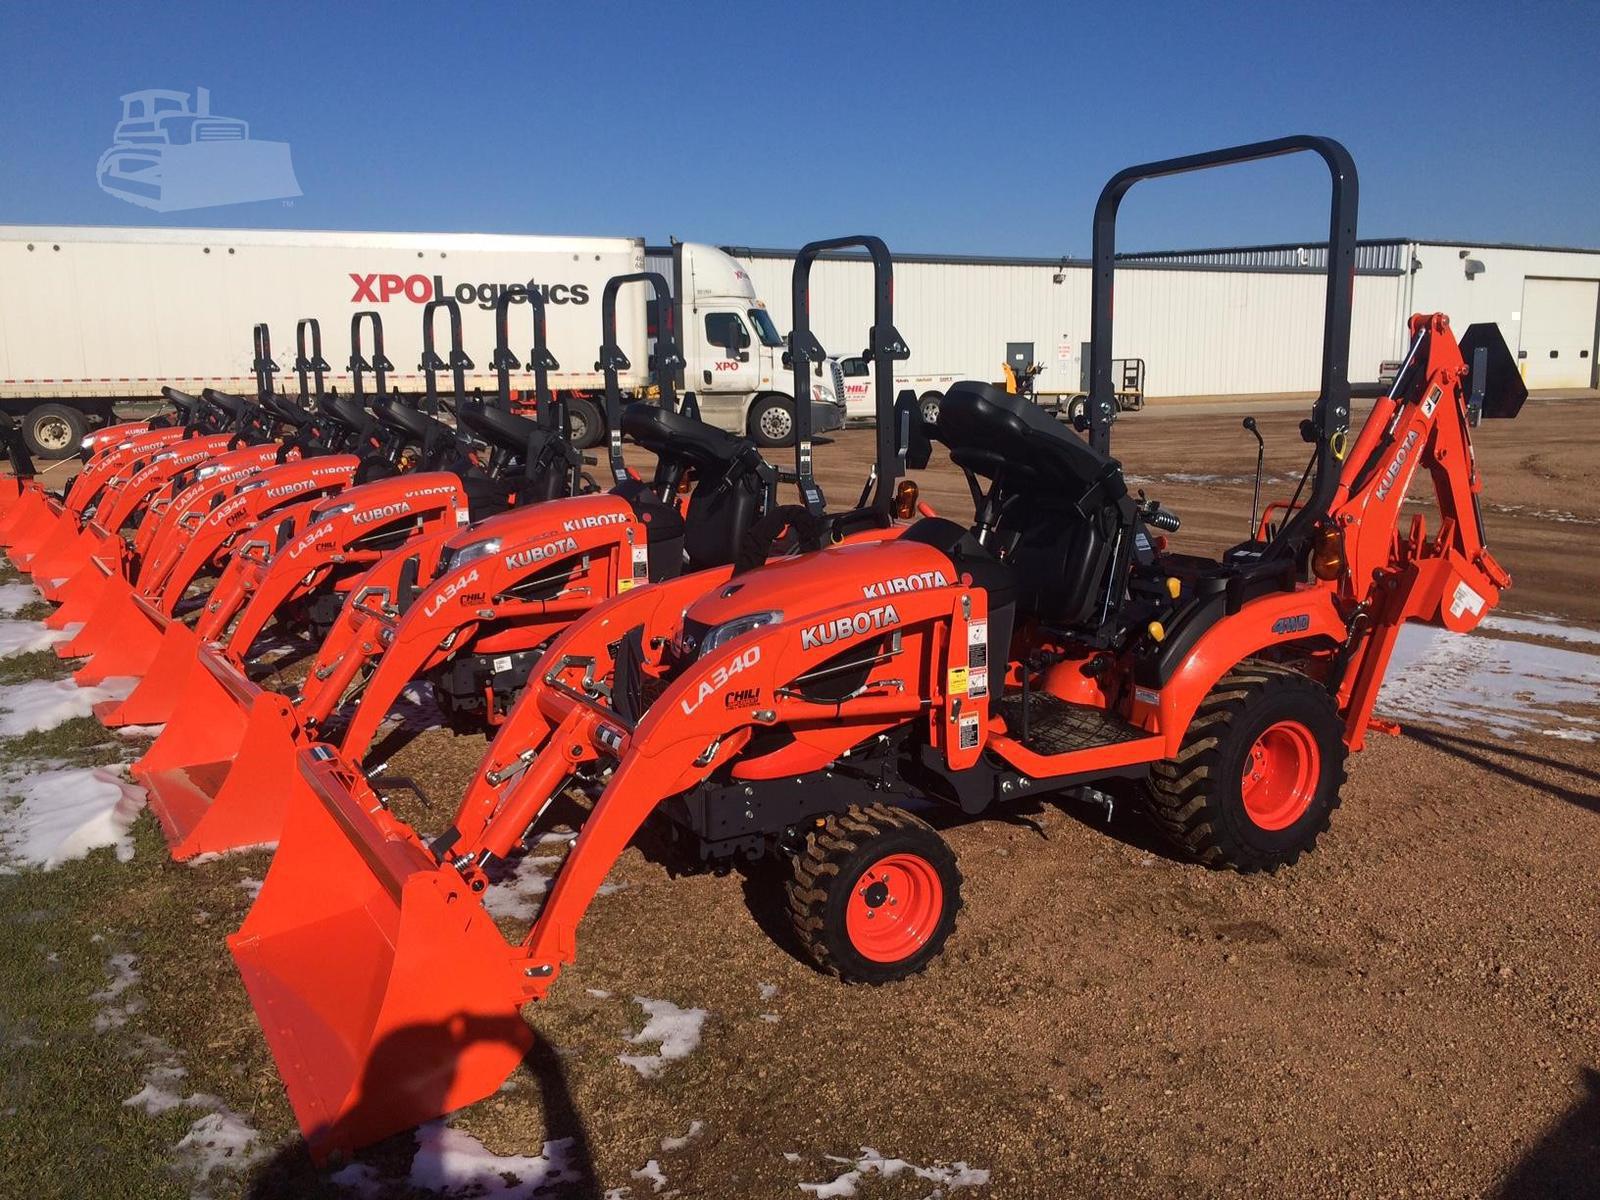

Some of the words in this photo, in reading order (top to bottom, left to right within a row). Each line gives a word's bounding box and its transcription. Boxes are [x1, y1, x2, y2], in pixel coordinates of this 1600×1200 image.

[715, 362, 739, 371] XPO
[845, 385, 868, 393] HILI
[173, 451, 210, 466] KUBOTA
[1375, 429, 1420, 502] KUBOTA
[219, 465, 262, 484] KUBOTA
[174, 484, 205, 511] LA344
[266, 479, 317, 499] KUBOTA
[210, 495, 247, 526] LA344
[352, 501, 412, 526] KUBOTA
[563, 513, 628, 532] KUBOTA
[288, 522, 334, 559] LA344
[505, 536, 578, 571] KUBOTA
[423, 569, 480, 618] LA344
[862, 571, 949, 599] KUBOTA
[460, 592, 486, 606] CHILI
[801, 604, 900, 650] KUBOTA
[681, 645, 761, 716] LA340
[724, 687, 761, 708] CHILI
